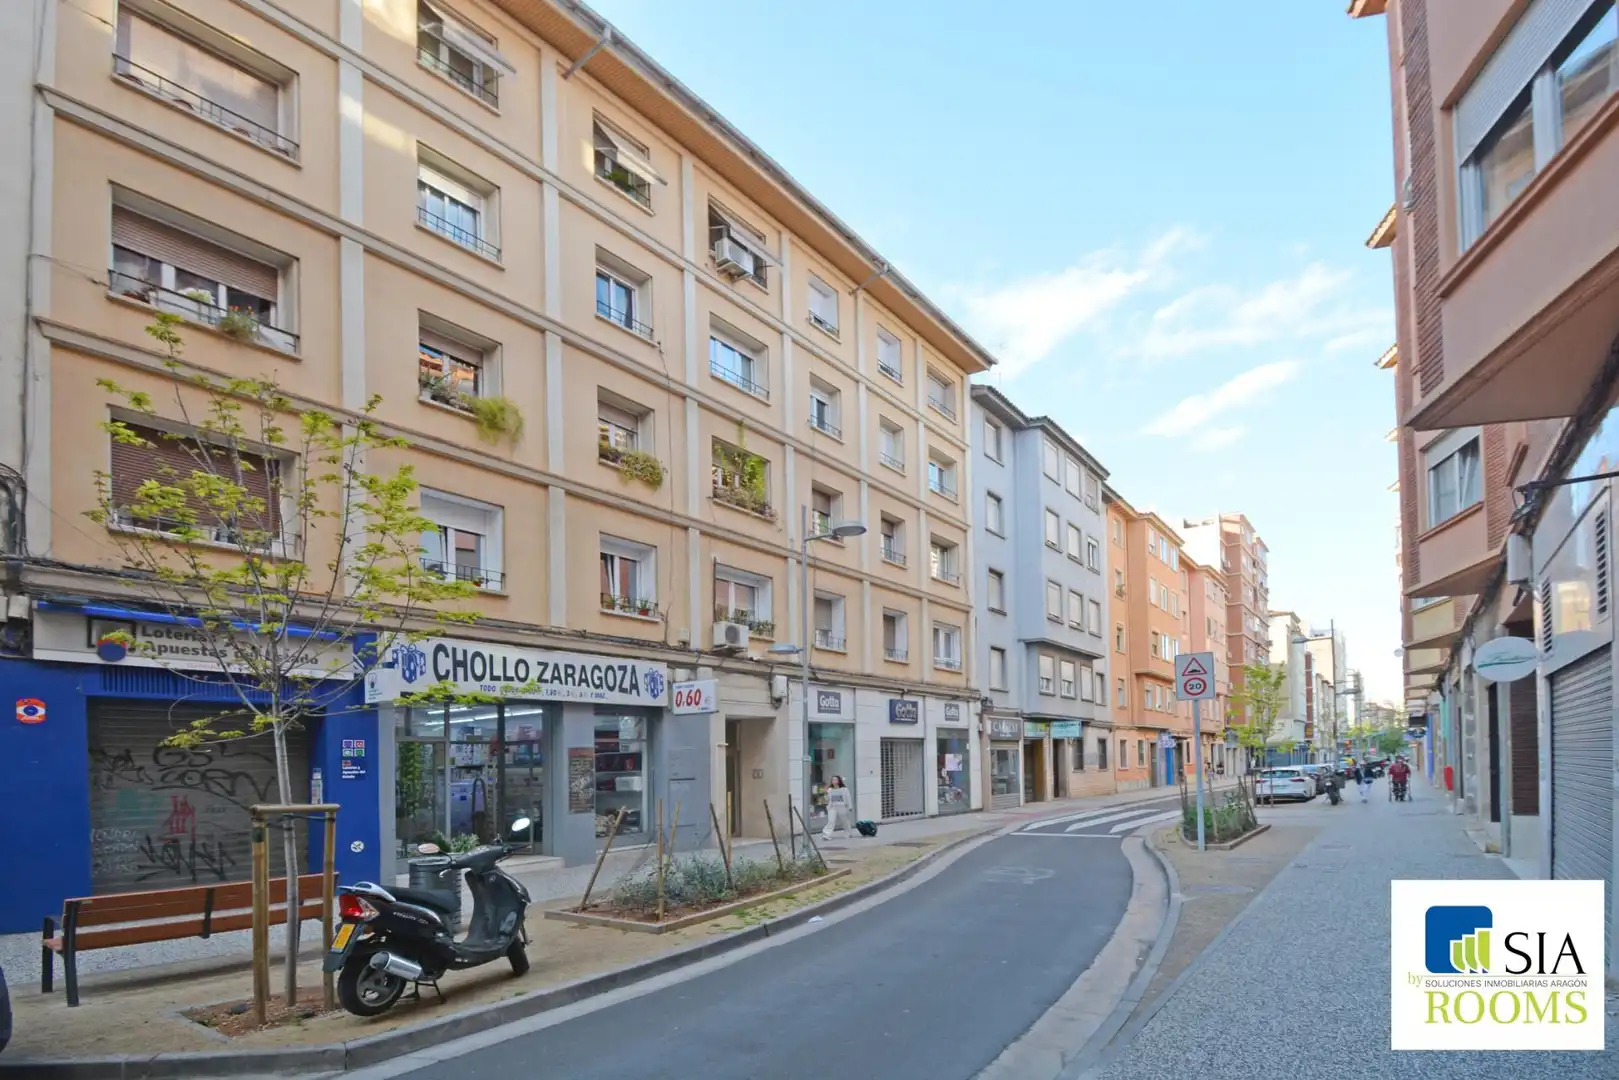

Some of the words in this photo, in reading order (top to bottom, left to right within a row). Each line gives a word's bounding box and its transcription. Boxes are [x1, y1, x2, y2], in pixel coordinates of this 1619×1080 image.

[432, 643, 530, 683] CHOLLO
[536, 660, 641, 697] ZARAGOZA
[1188, 682, 1202, 690] 20
